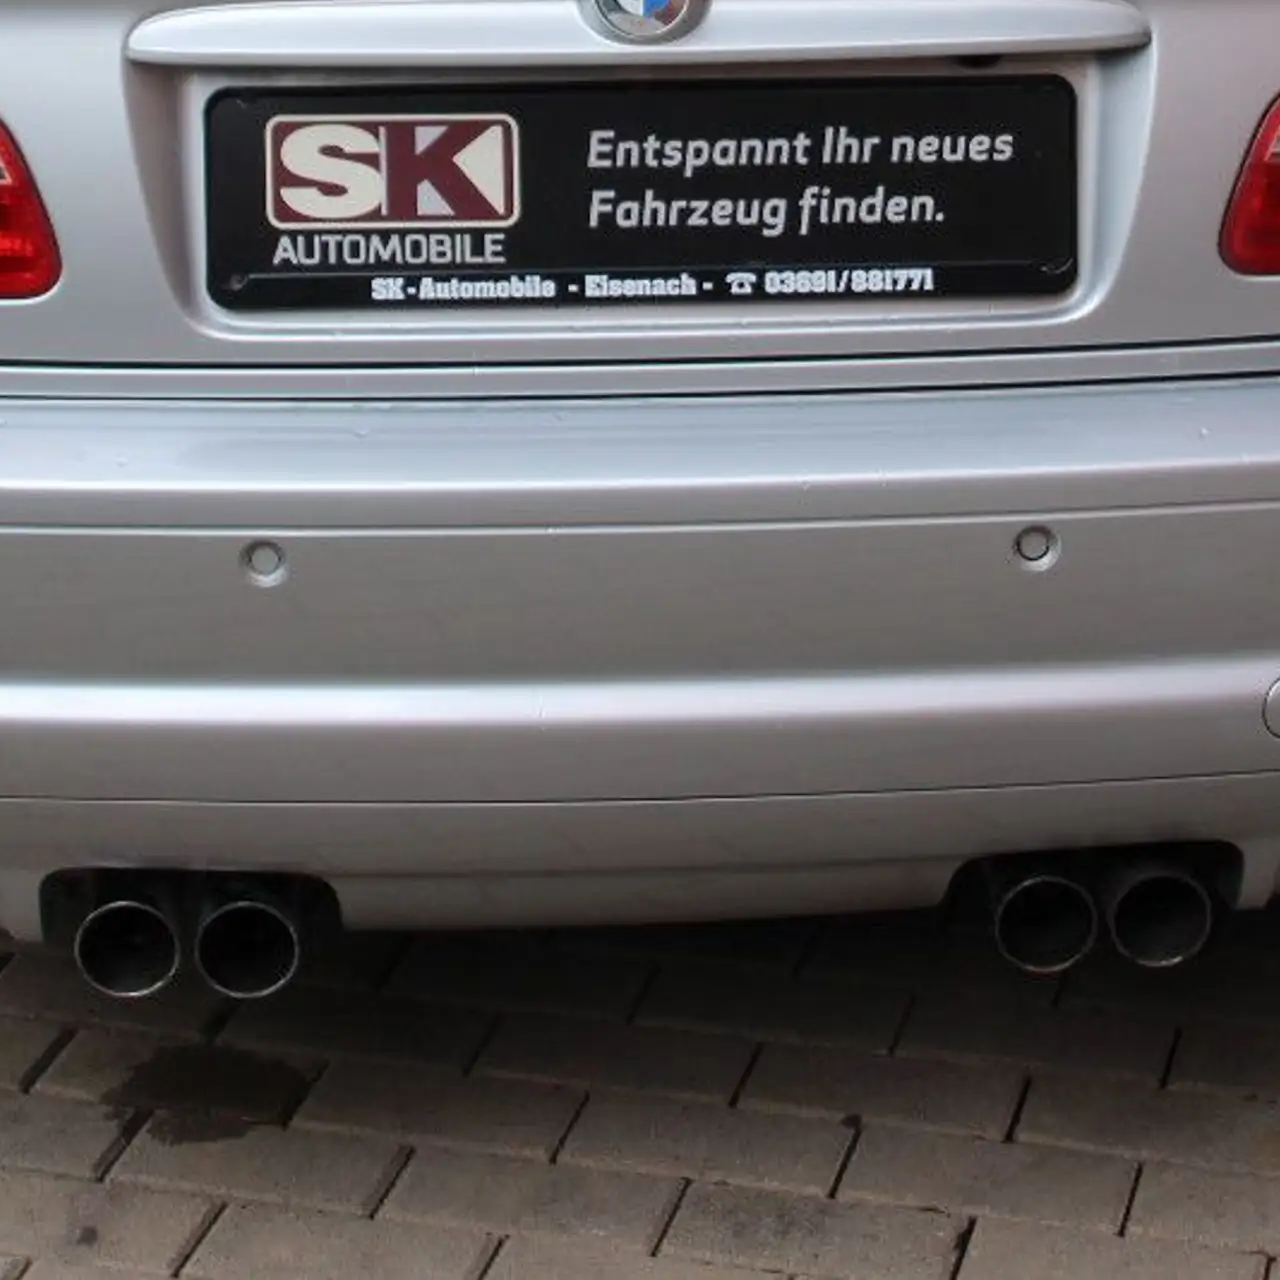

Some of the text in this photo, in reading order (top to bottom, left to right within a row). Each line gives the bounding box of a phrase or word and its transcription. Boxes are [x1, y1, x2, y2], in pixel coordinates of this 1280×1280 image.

[279, 123, 504, 219] SK
[586, 126, 1014, 178] Entspannt Ihr neues
[589, 185, 945, 237] Fahrzeug finden.
[273, 233, 506, 265] AUTOMOBILE
[370, 274, 556, 301] SK-Automobile
[584, 272, 697, 298] Eisenach
[764, 268, 934, 294] 03691/881771
